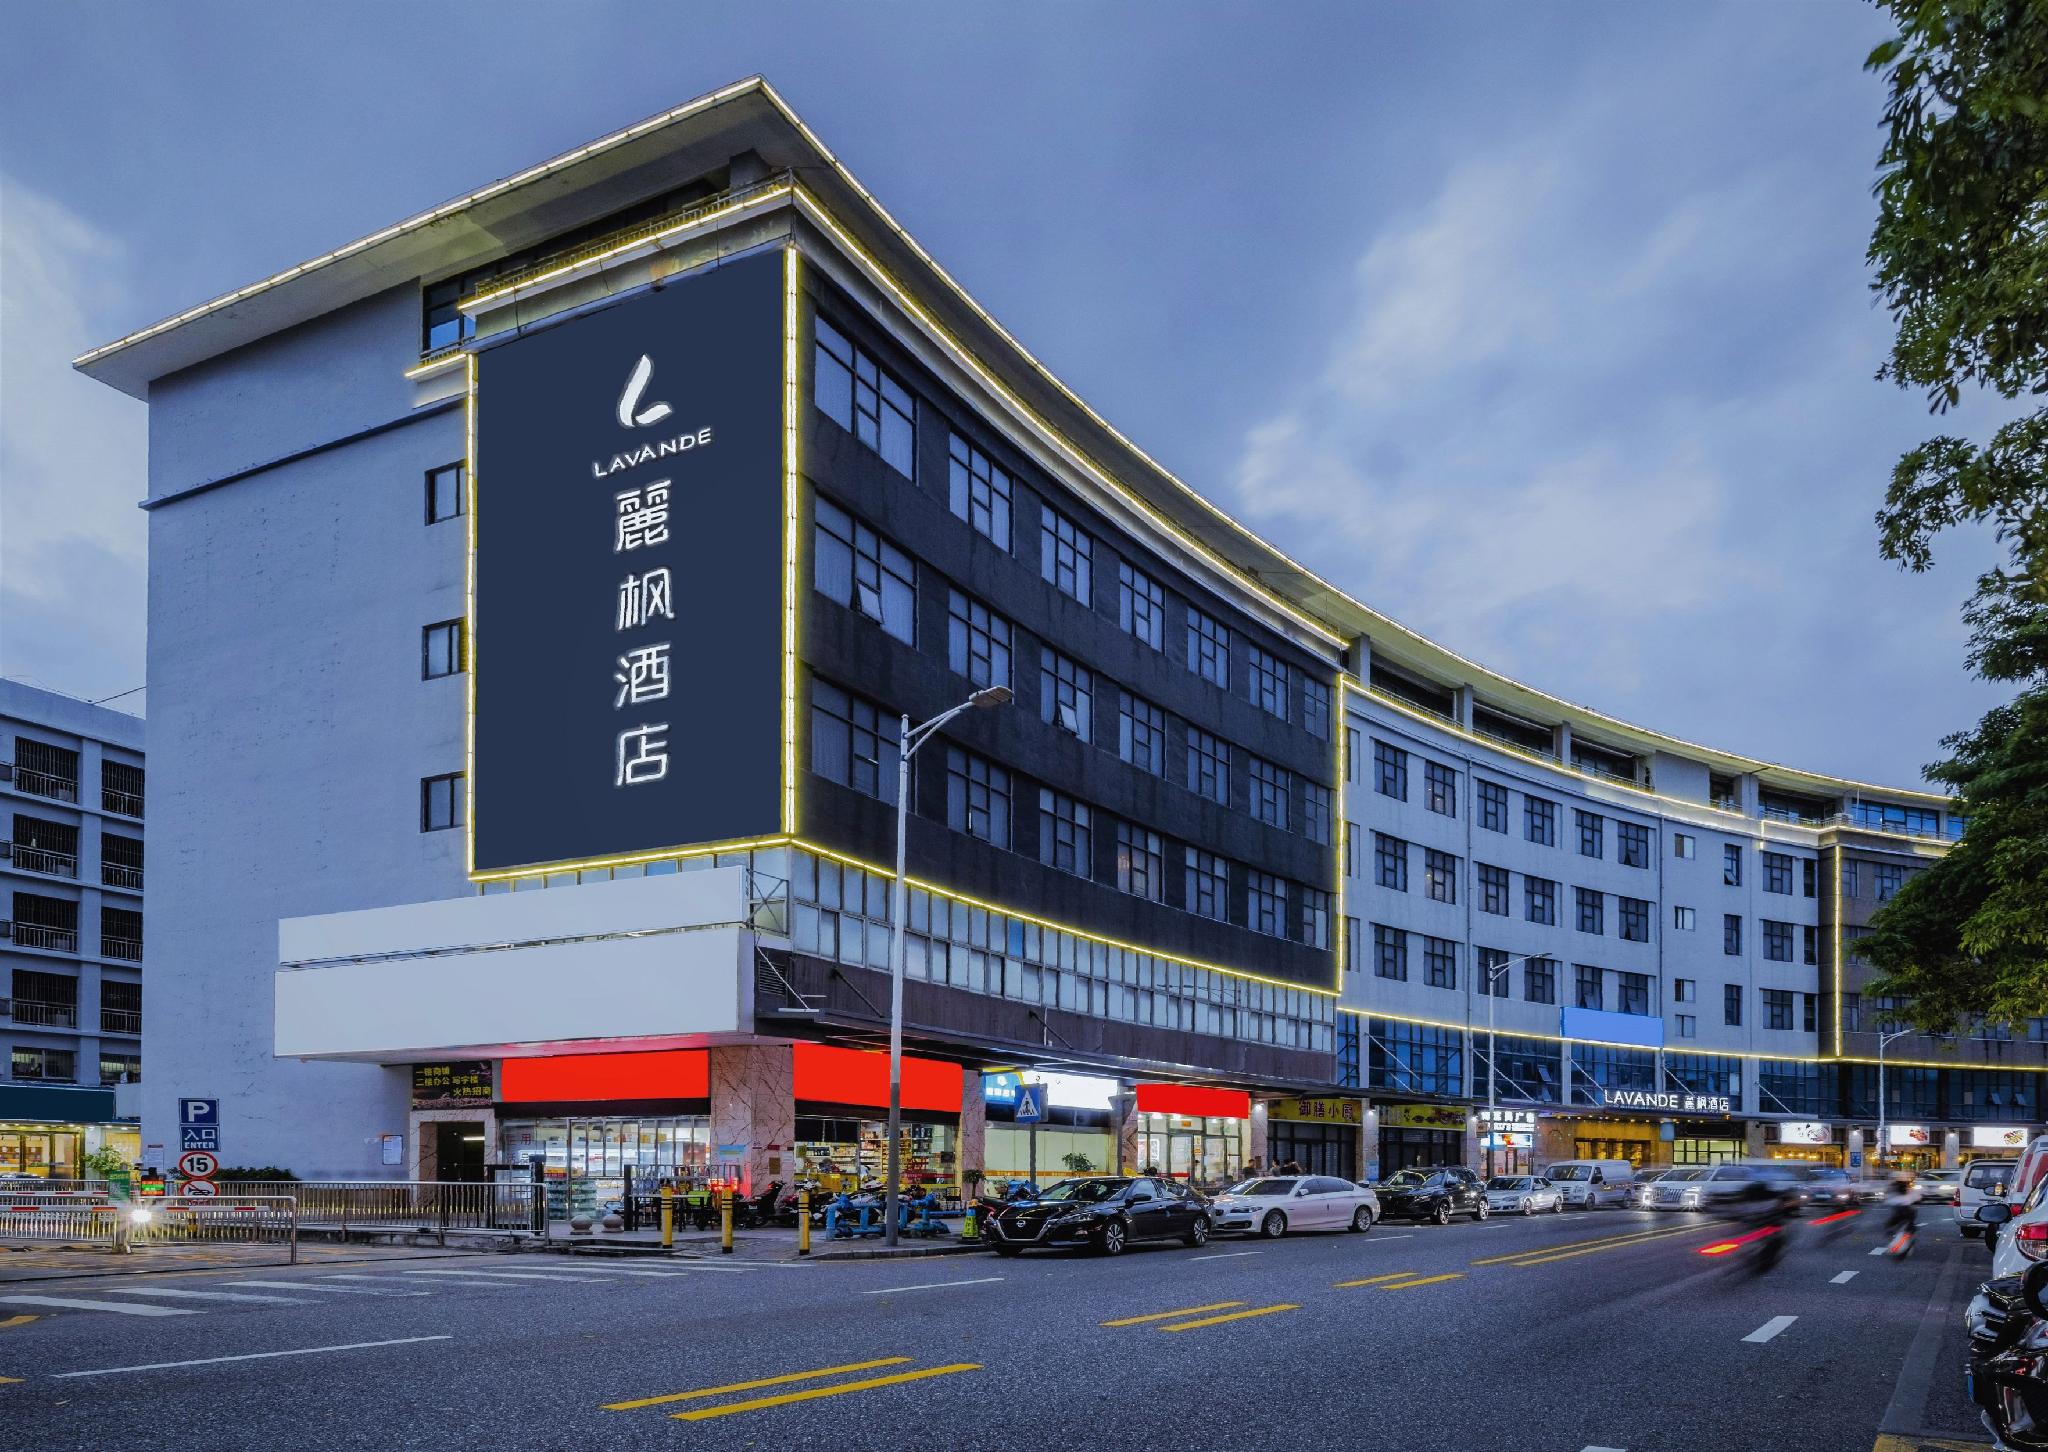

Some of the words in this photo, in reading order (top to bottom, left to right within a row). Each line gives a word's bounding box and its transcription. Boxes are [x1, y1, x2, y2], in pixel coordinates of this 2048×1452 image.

[593, 428, 712, 477] LAVANDE
[616, 480, 675, 786] 麗枫酒店
[1604, 1089, 1679, 1109] LAVANDE
[187, 1101, 210, 1123] P
[184, 1129, 216, 1141] 入口
[184, 1141, 215, 1149] ENTER
[187, 1157, 209, 1173] 15
